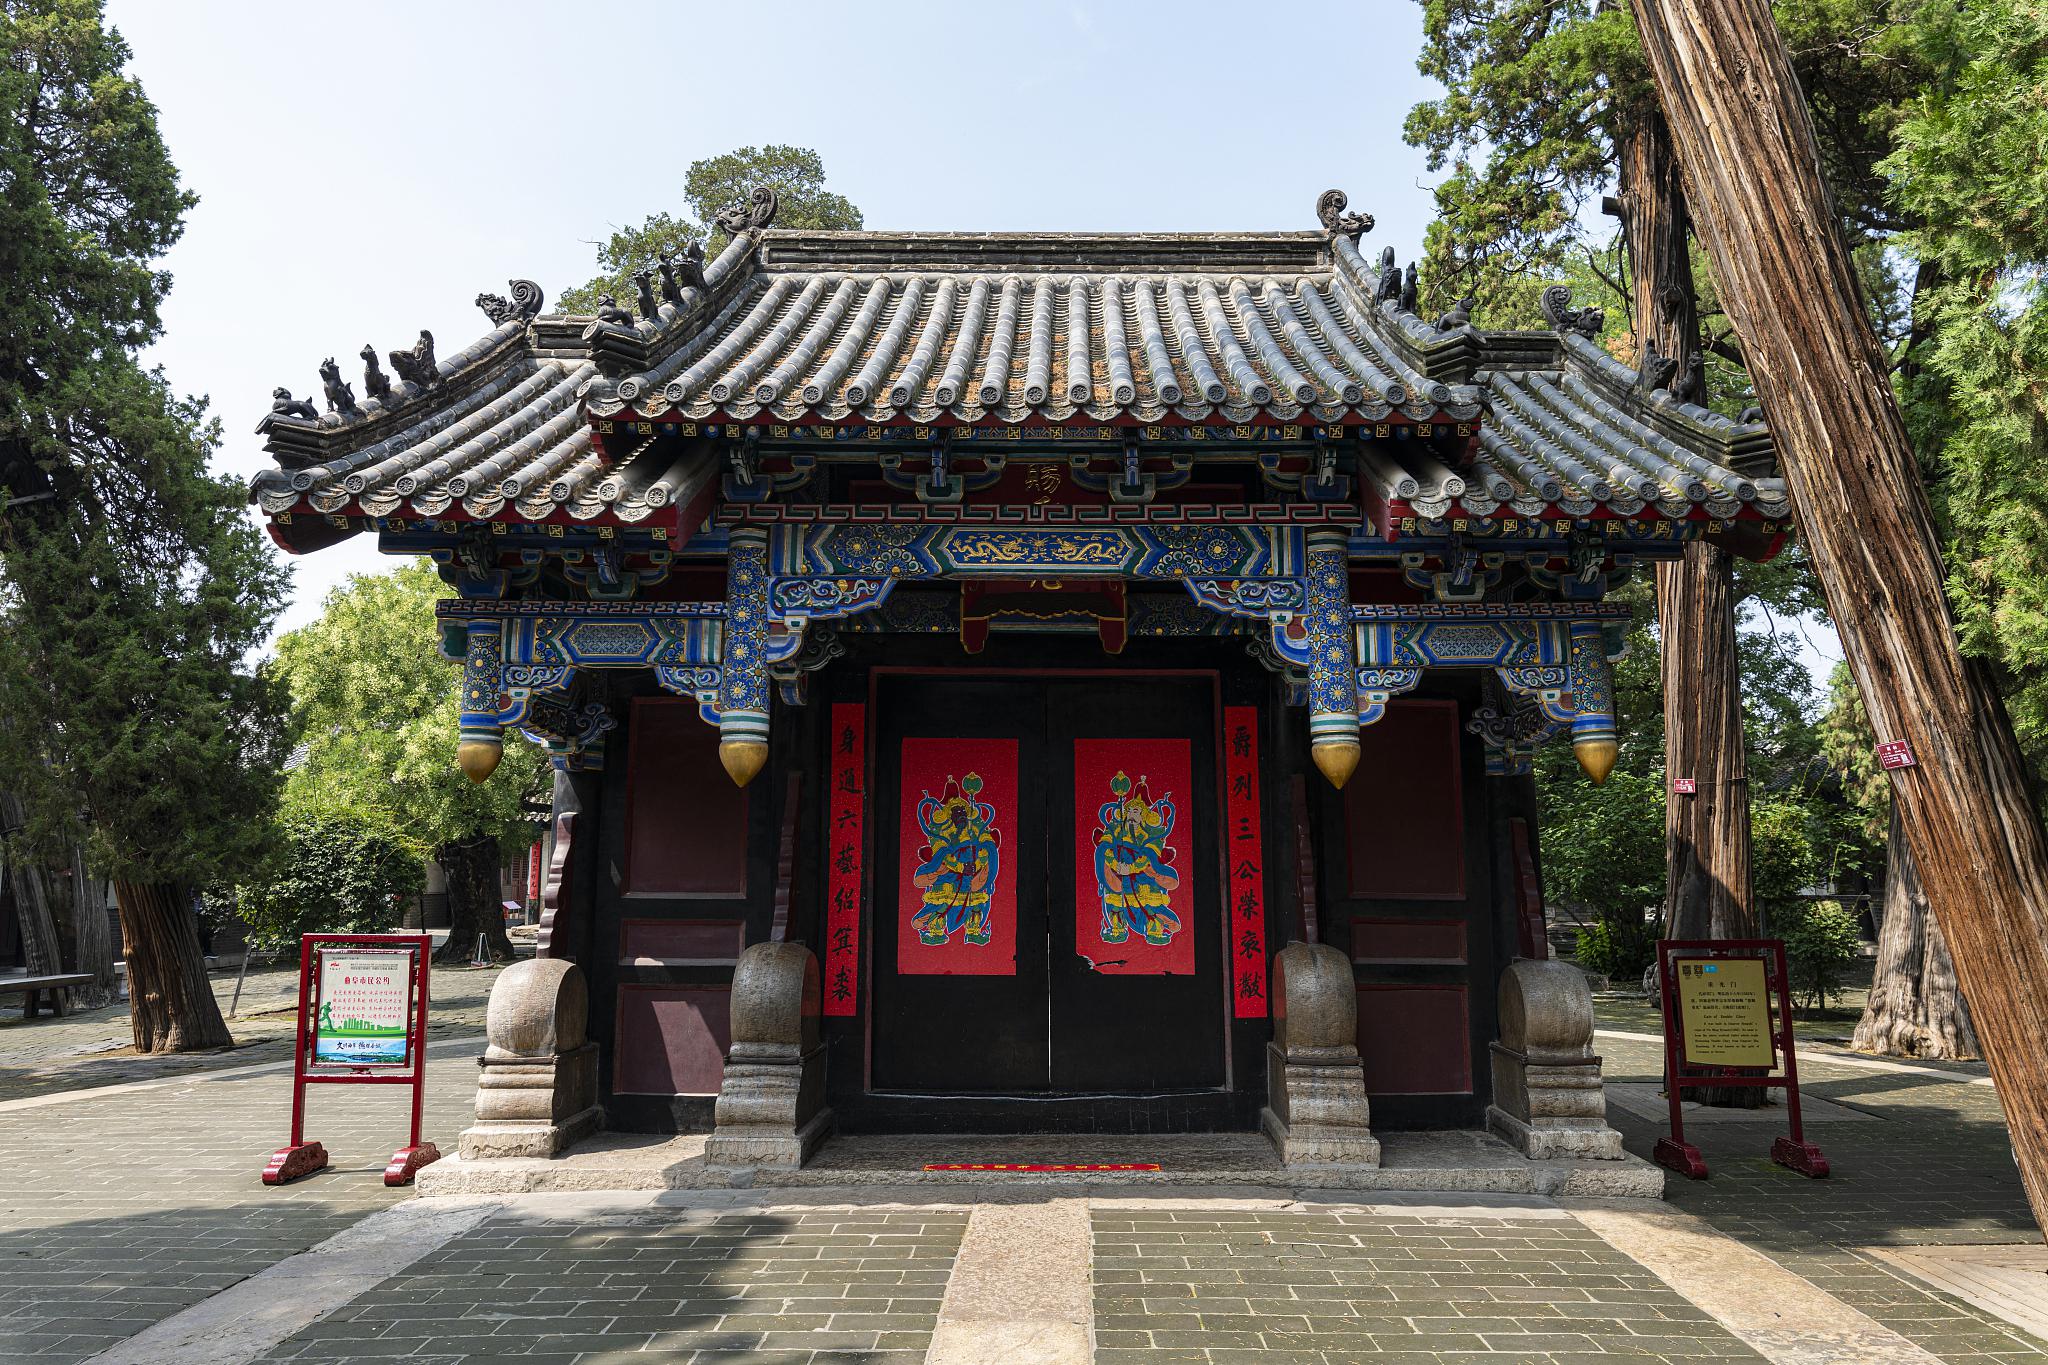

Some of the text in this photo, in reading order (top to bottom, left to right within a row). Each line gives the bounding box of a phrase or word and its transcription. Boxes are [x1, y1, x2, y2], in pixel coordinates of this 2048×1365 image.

[344, 976, 390, 985] 曲阜市民公约
